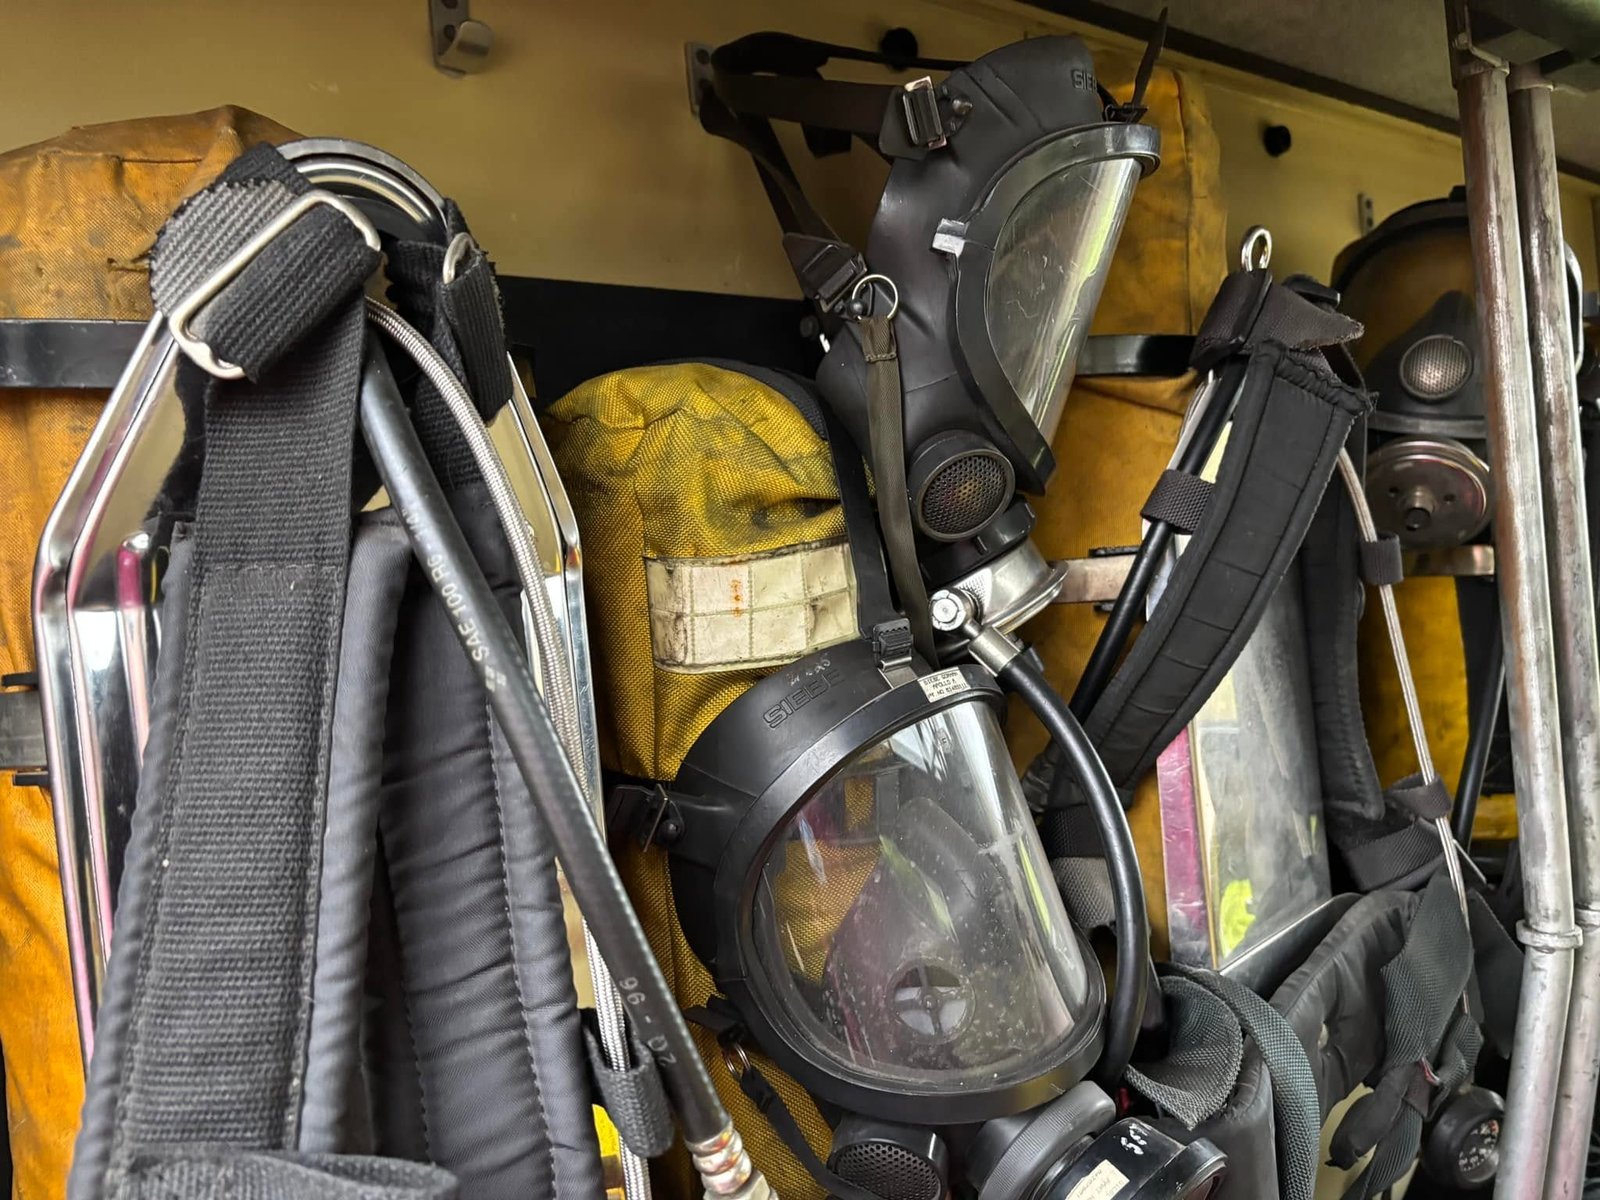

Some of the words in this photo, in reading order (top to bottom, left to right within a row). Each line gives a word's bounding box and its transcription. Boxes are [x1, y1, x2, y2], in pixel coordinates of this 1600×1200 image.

[441, 583, 467, 618] 100
[458, 618, 490, 662] SAE
[763, 669, 846, 729] SIEBE
[619, 976, 647, 1006] 96
